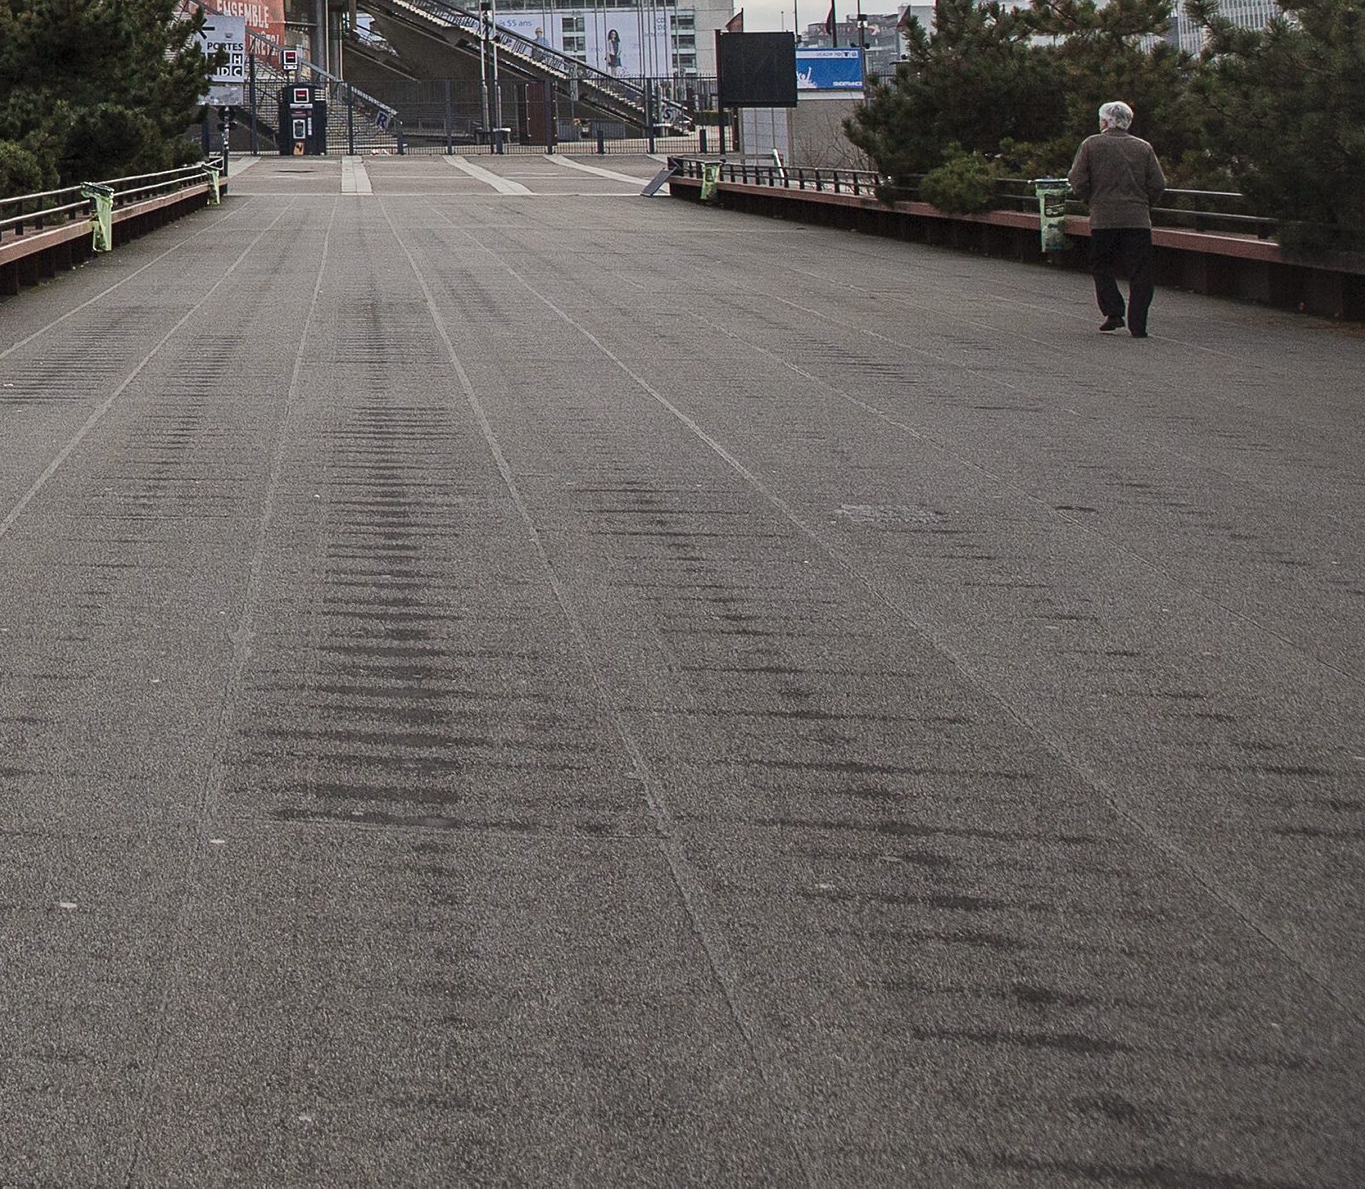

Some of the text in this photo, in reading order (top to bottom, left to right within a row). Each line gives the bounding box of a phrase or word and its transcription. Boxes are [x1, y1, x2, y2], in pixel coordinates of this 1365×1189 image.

[233, 54, 241, 65] H
[220, 66, 229, 77] D
[233, 66, 241, 77] C
